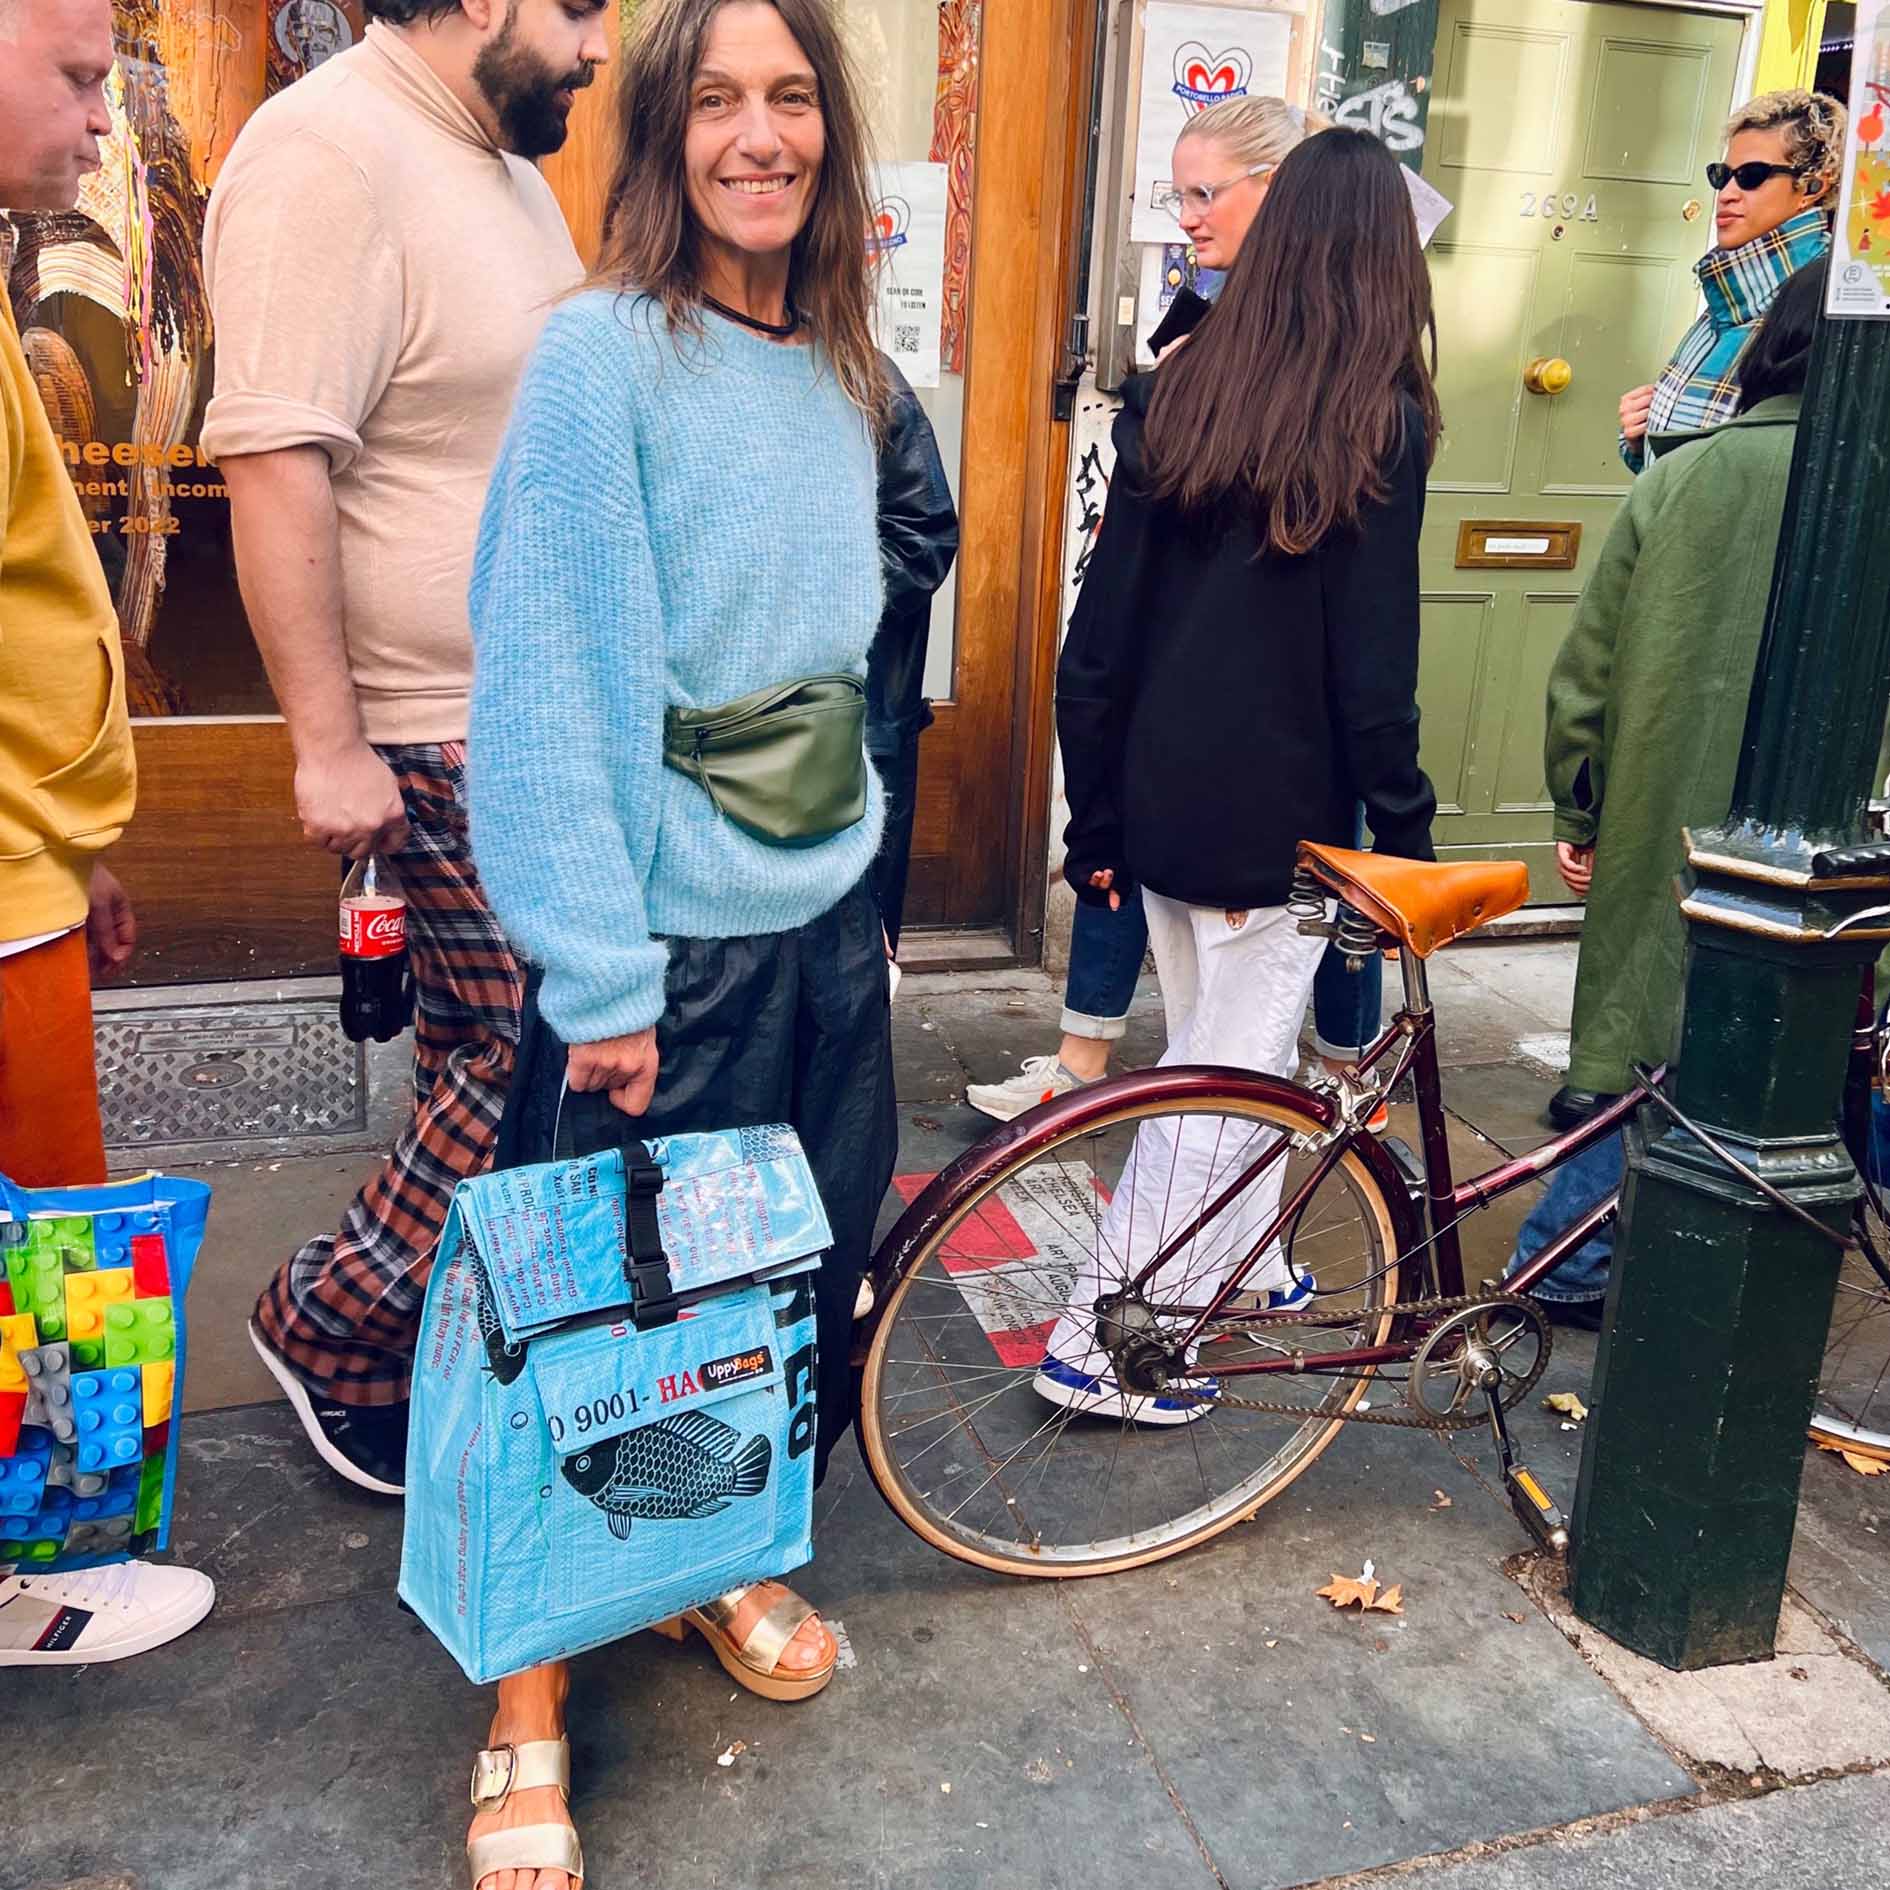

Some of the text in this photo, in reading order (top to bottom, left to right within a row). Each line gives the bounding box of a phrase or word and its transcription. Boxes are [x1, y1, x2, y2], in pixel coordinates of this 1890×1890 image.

[1519, 192, 1598, 222] 269A
[151, 479, 231, 498] Incom
[90, 516, 181, 534] er 2022
[1024, 1178, 1048, 1196] ART
[1041, 1176, 1081, 1218] CHELSEA
[1046, 1244, 1069, 1265] ART
[708, 1351, 765, 1380] UppyBags
[574, 1387, 650, 1433] 9001-
[656, 1369, 705, 1404] HA
[47, 1615, 72, 1648] HILFIGER
